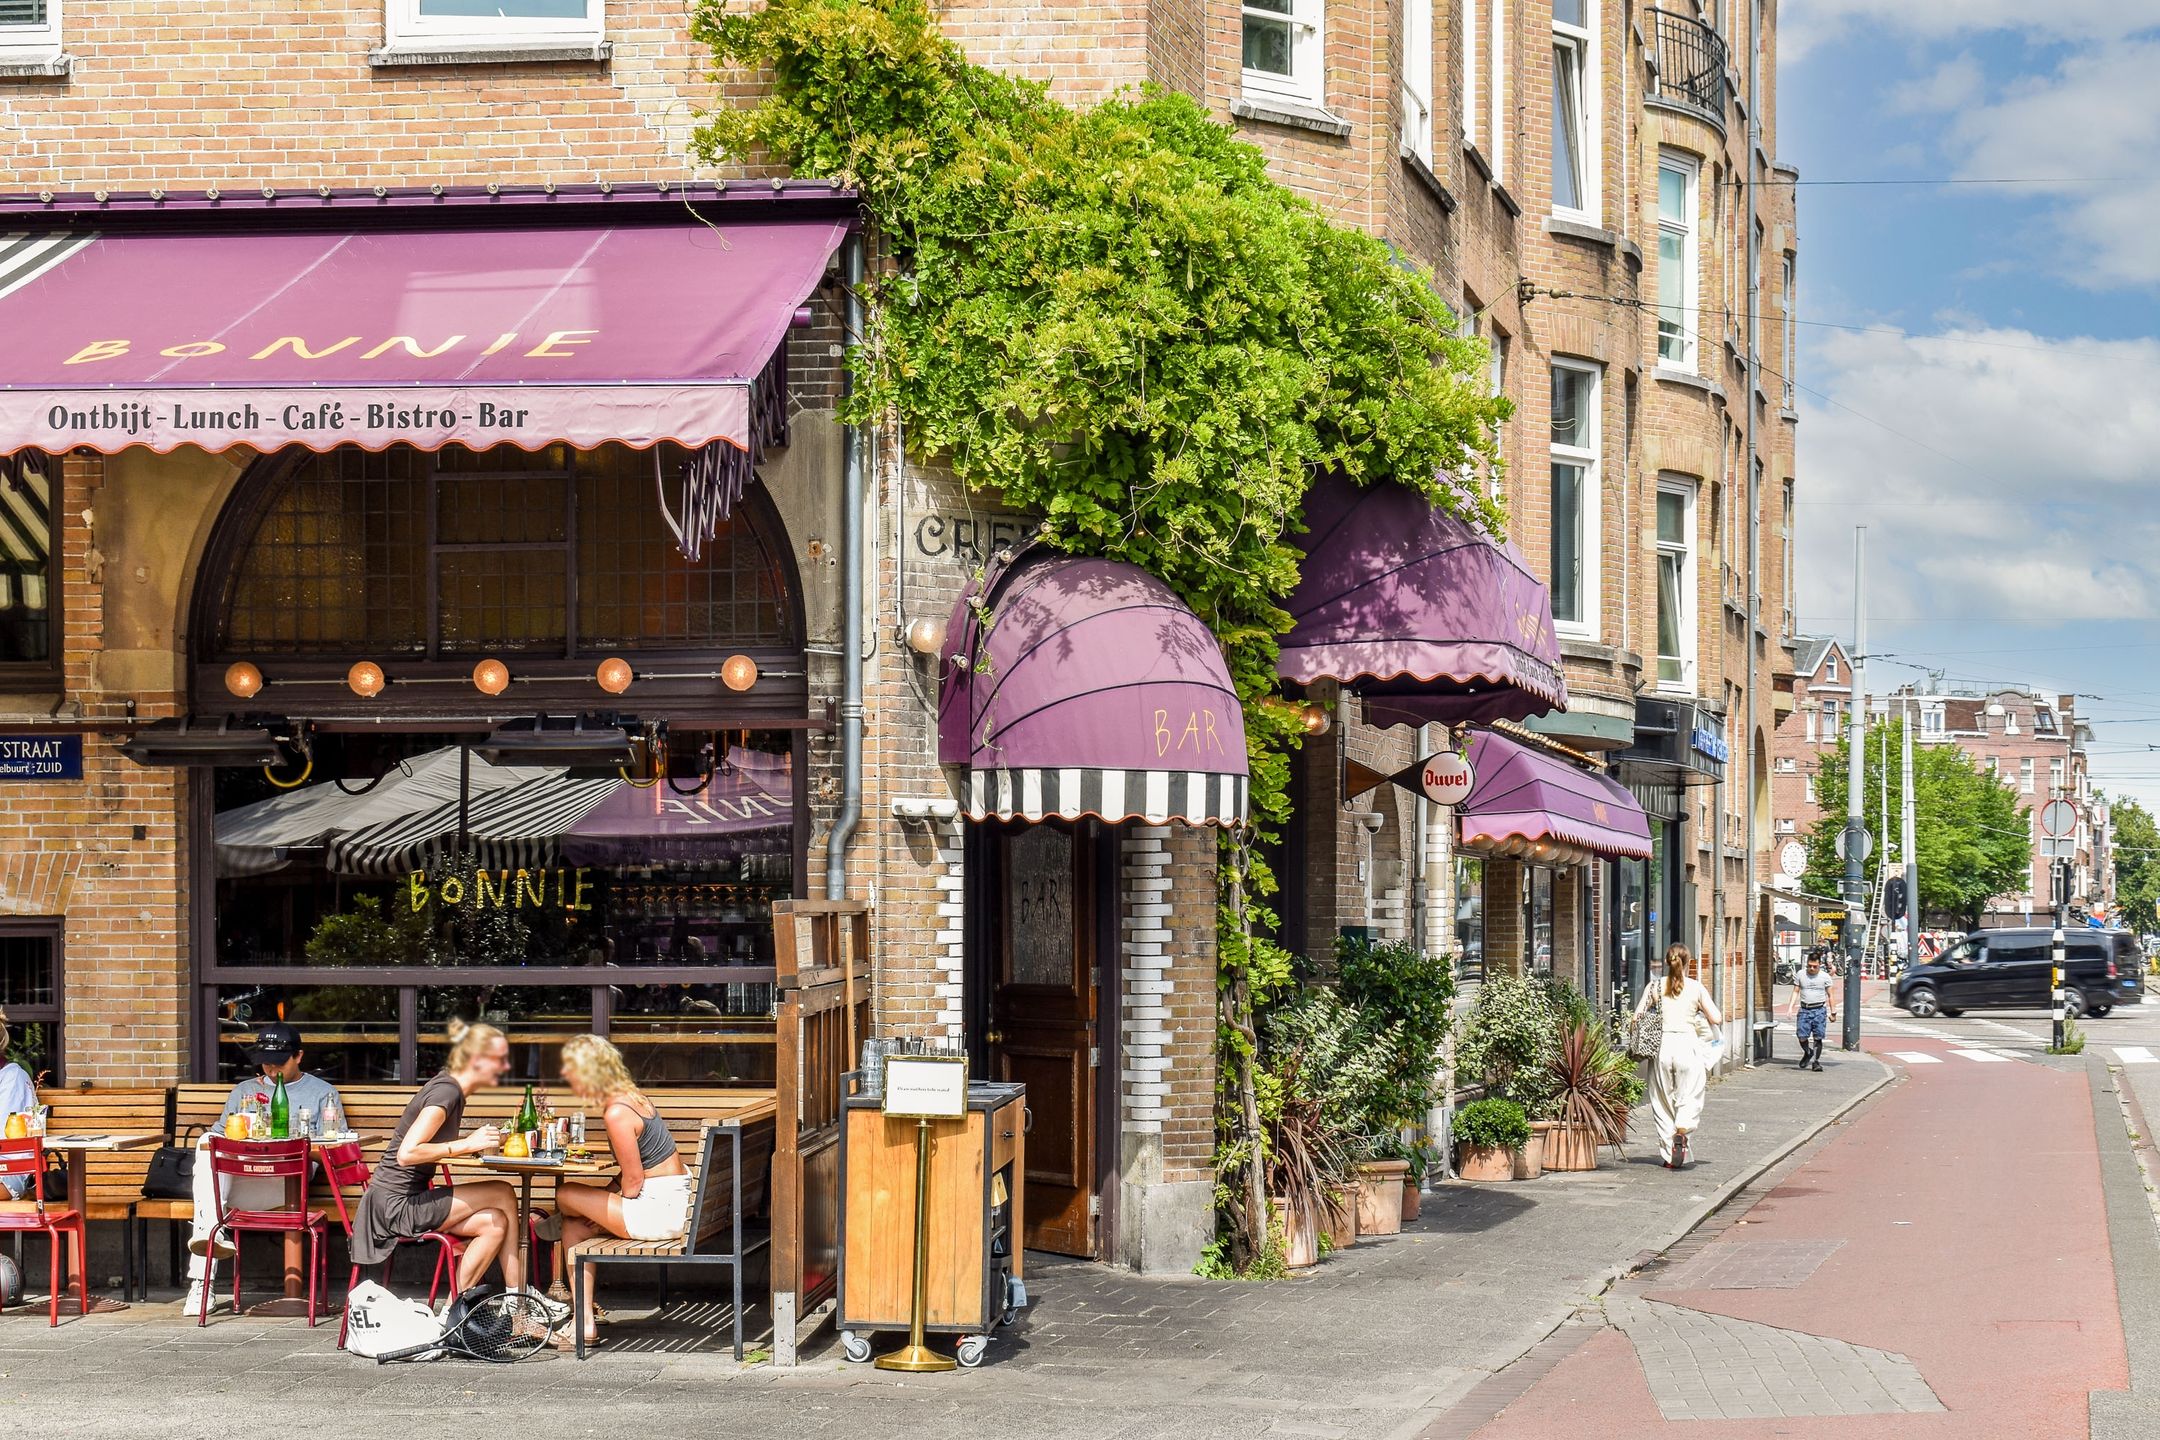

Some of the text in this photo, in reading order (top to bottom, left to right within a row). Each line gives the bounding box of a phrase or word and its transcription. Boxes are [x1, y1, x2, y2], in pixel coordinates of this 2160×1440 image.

[63, 329, 600, 365] BONNIE
[48, 402, 152, 435] Ontbijt
[173, 404, 259, 429] Lunch
[283, 402, 345, 430] Café
[367, 404, 457, 429] Bistro
[479, 402, 529, 428] Bar
[1154, 709, 1225, 758] BAR
[36, 762, 63, 773] ZUID
[1425, 769, 1468, 787] Duvel
[1021, 879, 1062, 925] BAR
